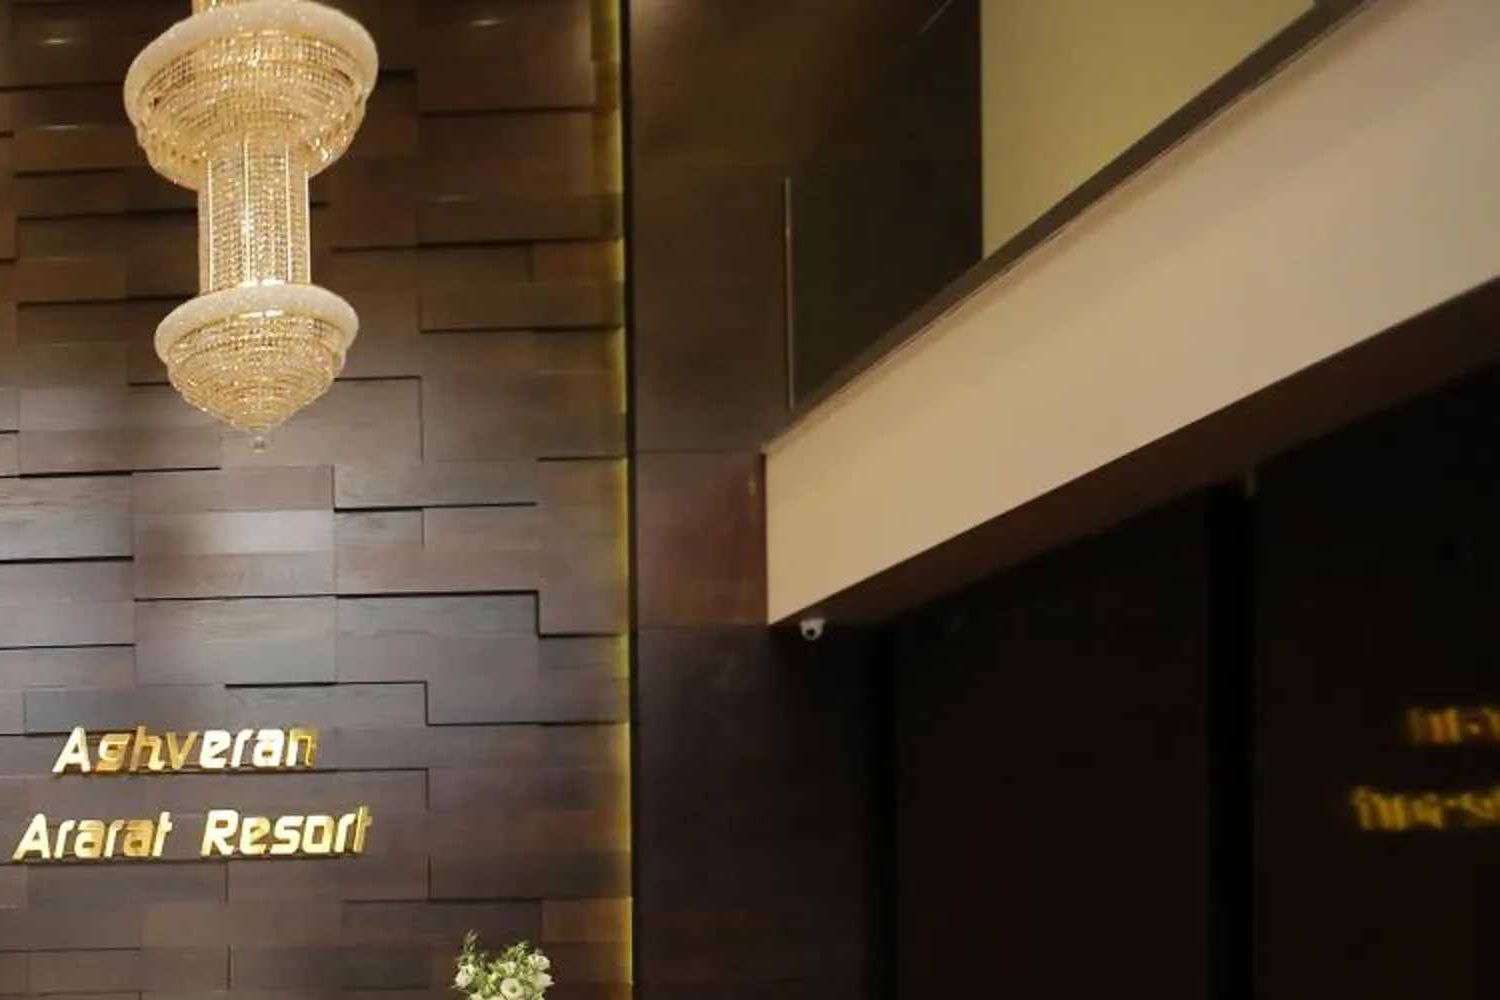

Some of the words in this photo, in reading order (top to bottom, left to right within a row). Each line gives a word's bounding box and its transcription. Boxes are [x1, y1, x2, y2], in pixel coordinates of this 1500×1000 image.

[51, 725, 318, 774] Aghveran
[13, 811, 173, 861] Ararat
[200, 805, 373, 858] Resort
